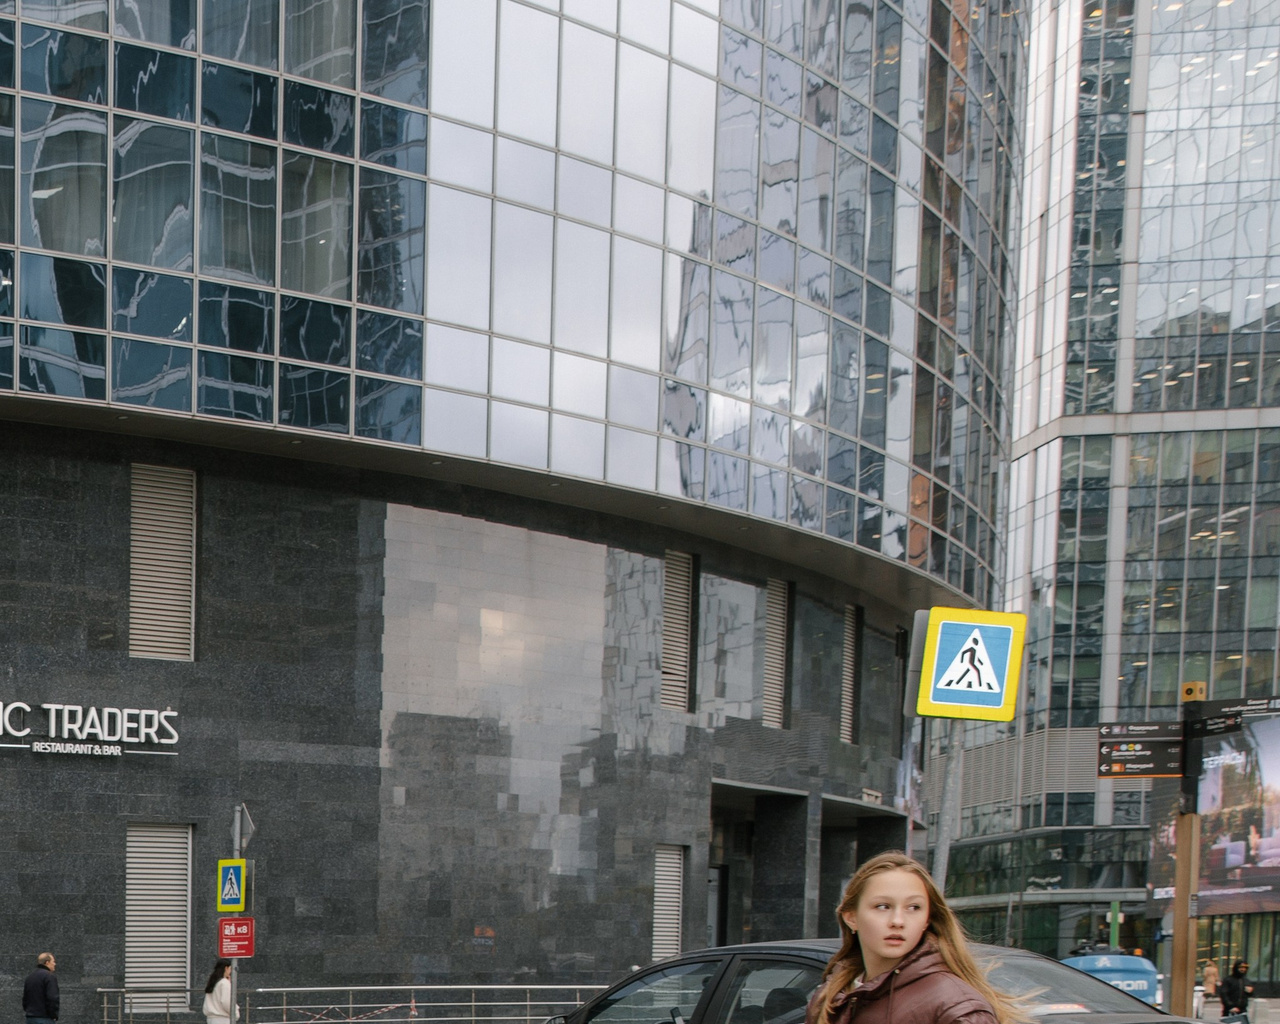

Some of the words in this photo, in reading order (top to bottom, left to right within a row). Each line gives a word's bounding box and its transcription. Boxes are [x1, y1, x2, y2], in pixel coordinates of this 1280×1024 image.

[41, 703, 179, 744] TRADERS
[32, 742, 93, 755] RESTAURANT
[93, 745, 102, 755] &
[102, 745, 122, 756] BAR
